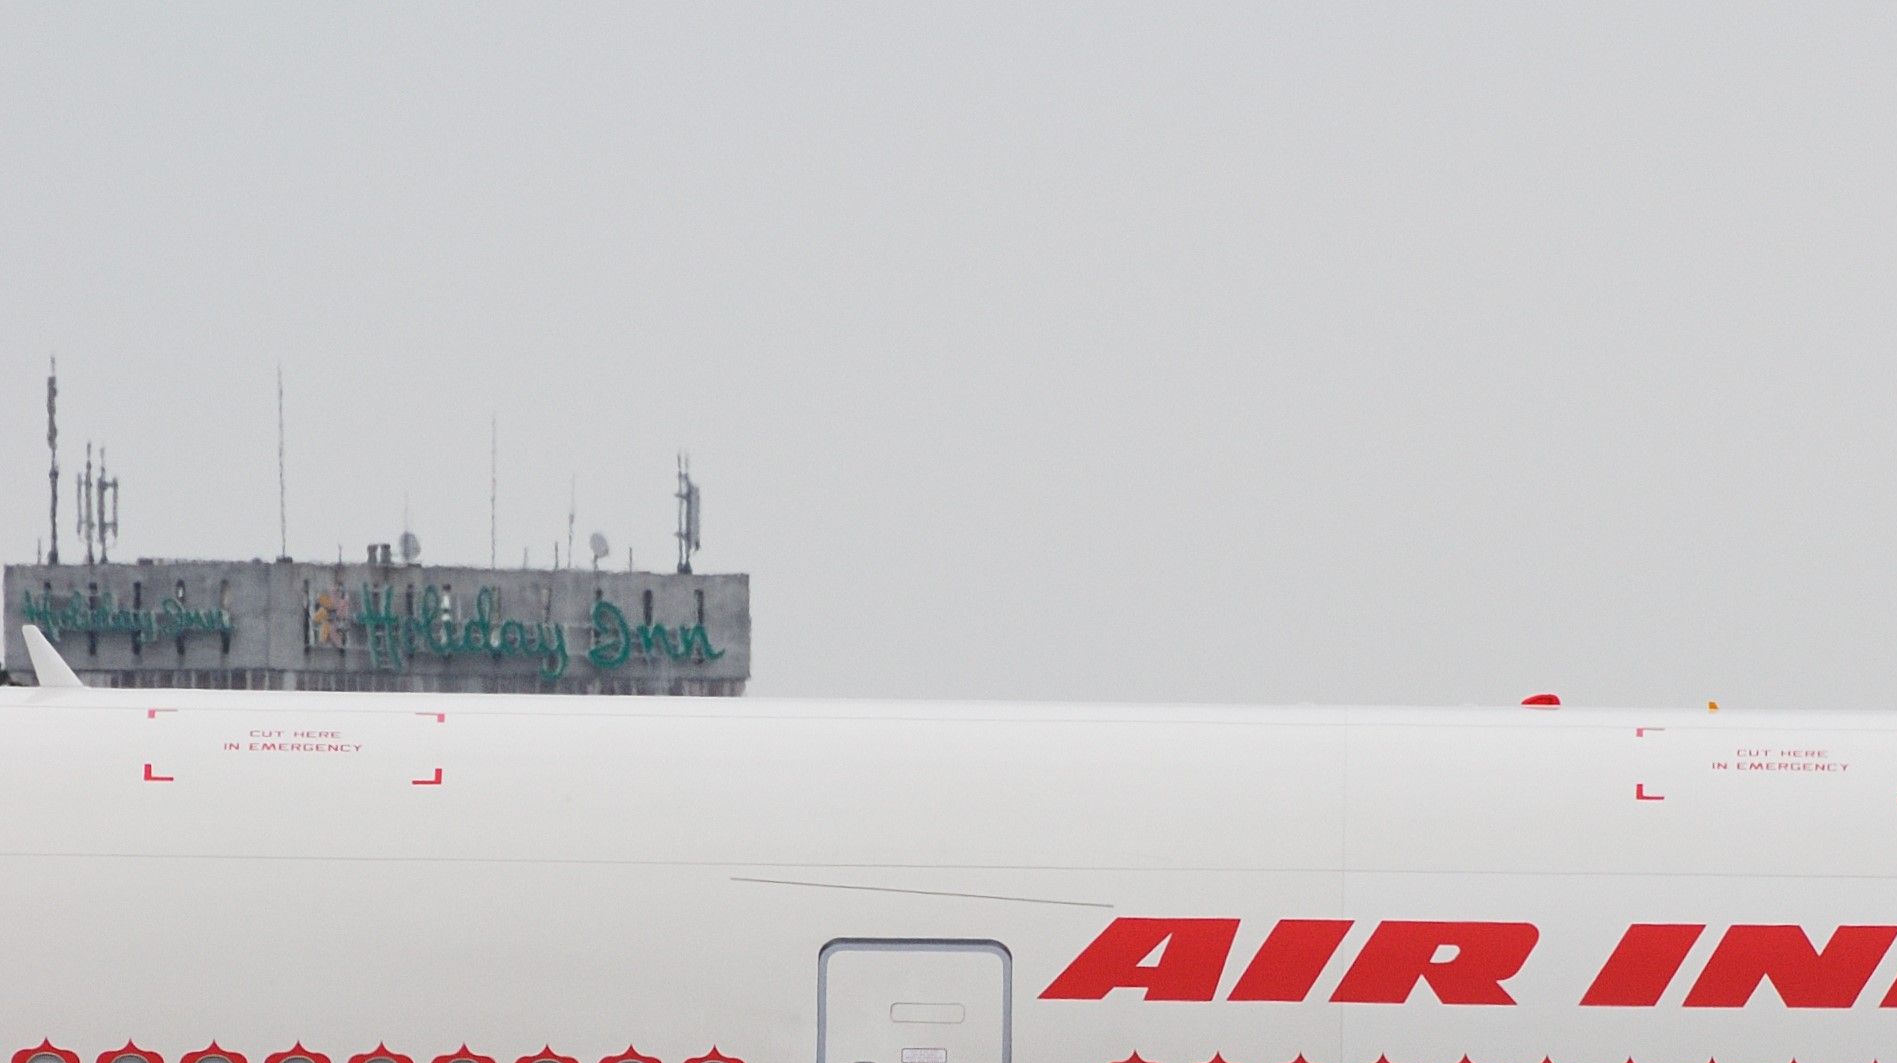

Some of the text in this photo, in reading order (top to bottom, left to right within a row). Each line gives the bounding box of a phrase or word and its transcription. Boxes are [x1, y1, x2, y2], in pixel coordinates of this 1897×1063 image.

[356, 582, 724, 682] Holiday Inn
[250, 730, 342, 739] CUT HERE
[224, 743, 362, 752] IN EMERGENCY
[1736, 749, 1829, 758] CUT HERE
[1712, 762, 1849, 772] IN EMERGENCY
[1039, 916, 1541, 1006] AIR
